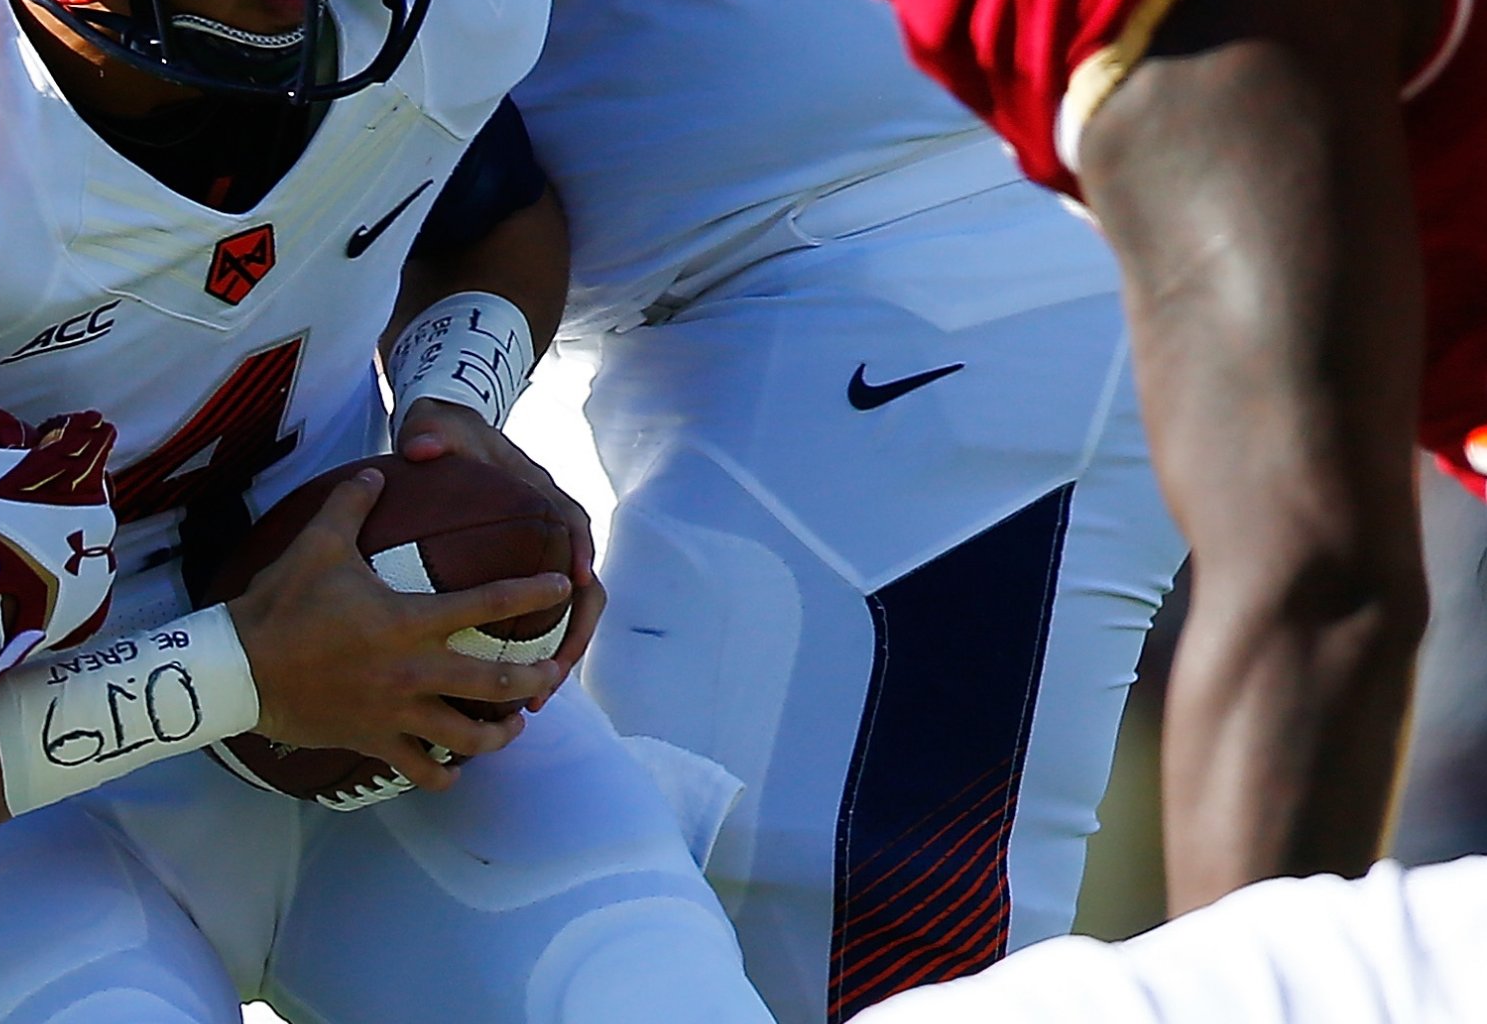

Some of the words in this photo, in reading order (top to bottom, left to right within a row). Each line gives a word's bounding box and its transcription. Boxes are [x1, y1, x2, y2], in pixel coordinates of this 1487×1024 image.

[0, 298, 122, 364] ACC
[47, 640, 138, 685] GREAT
[150, 630, 190, 651] BE
